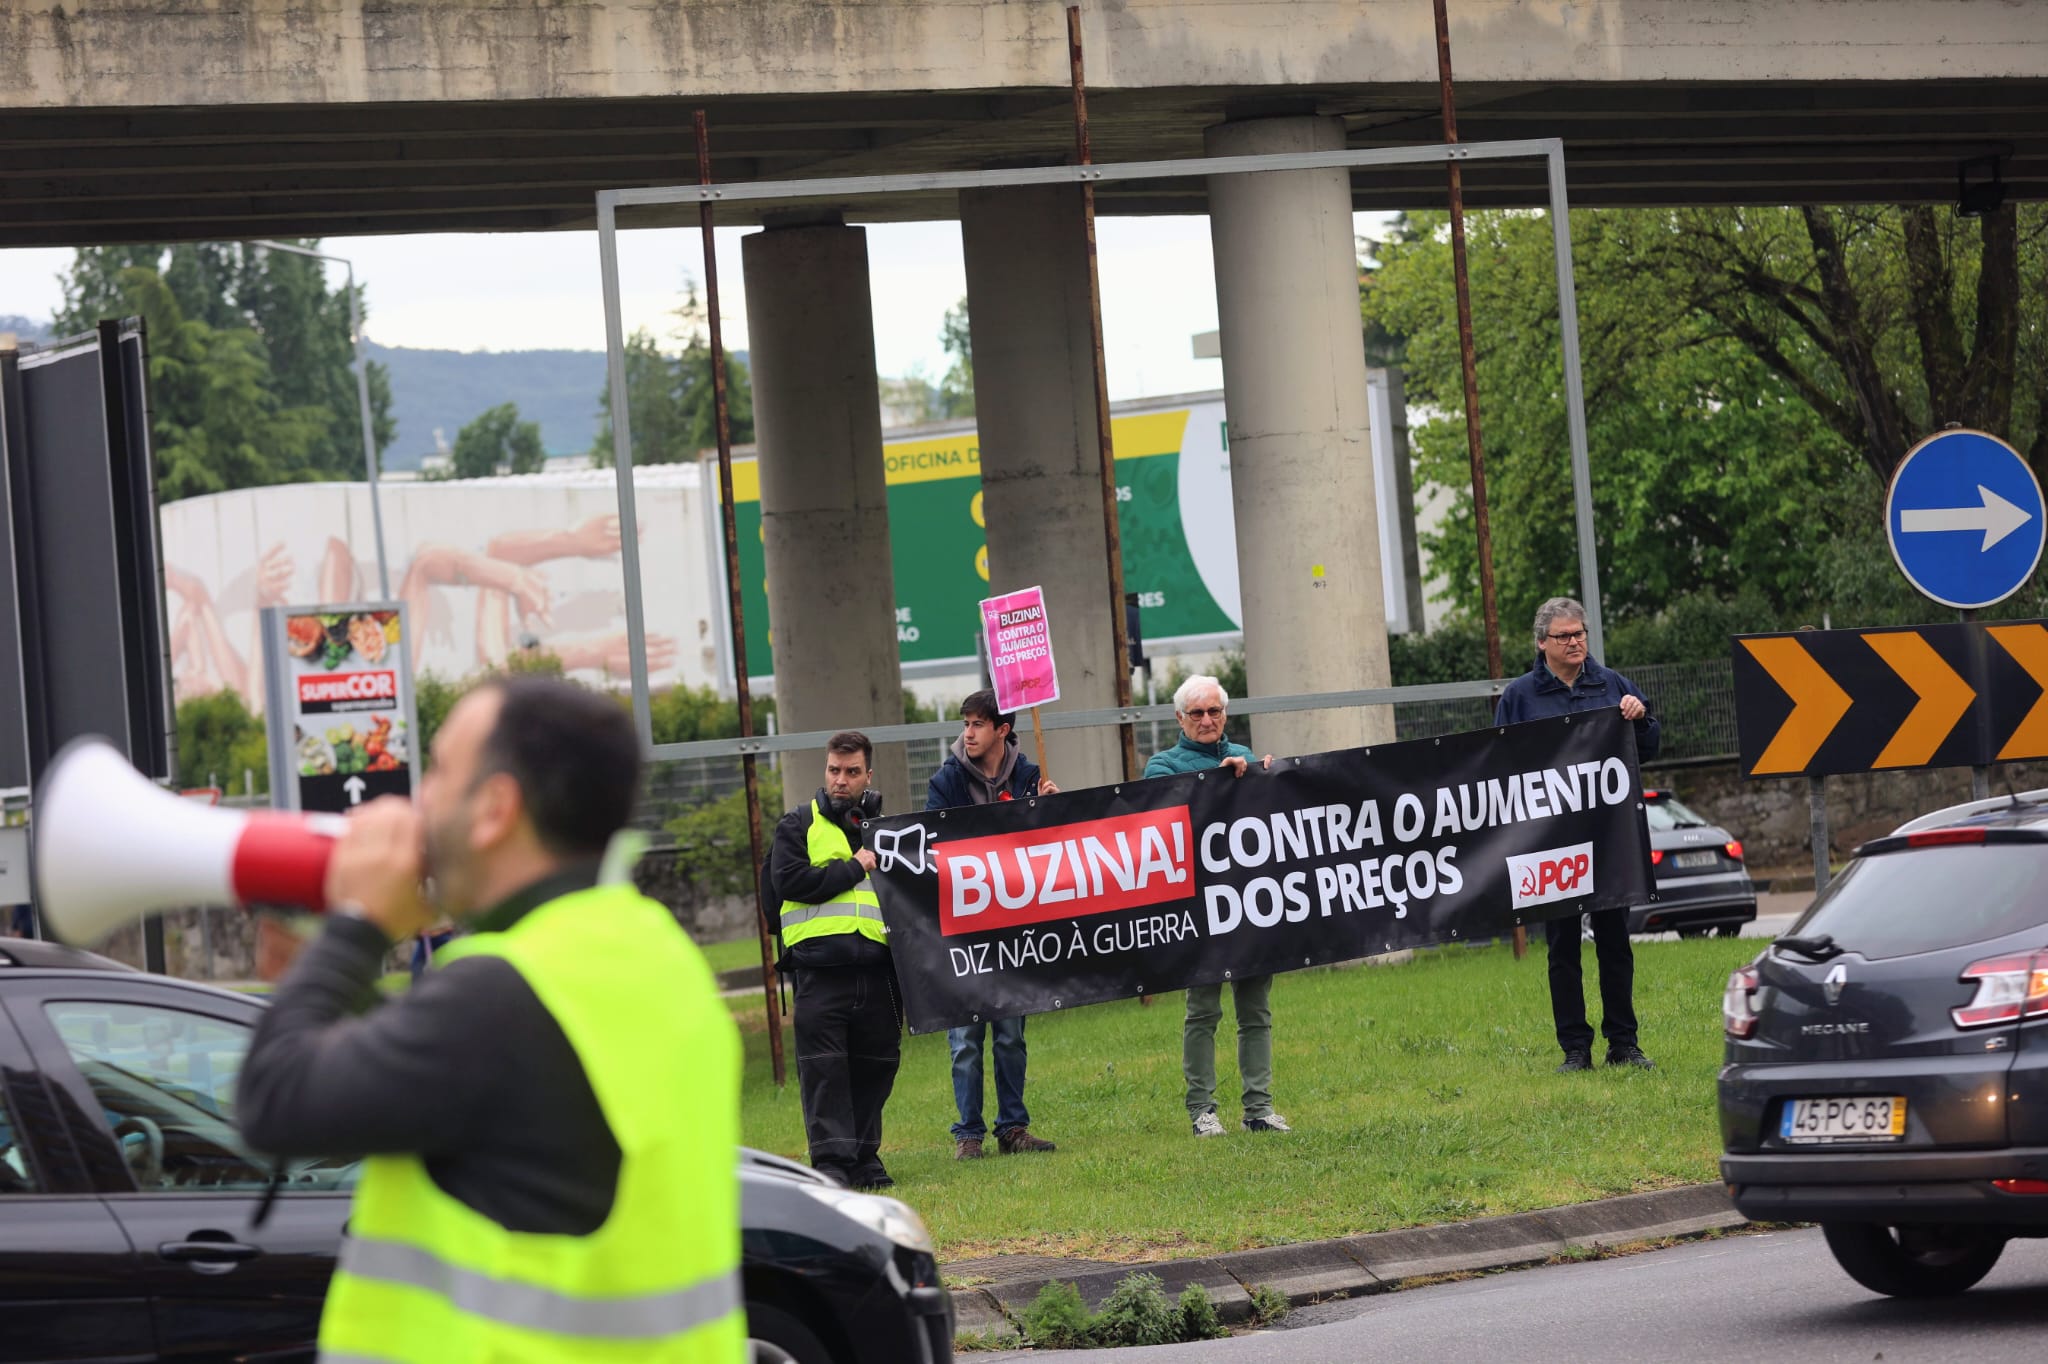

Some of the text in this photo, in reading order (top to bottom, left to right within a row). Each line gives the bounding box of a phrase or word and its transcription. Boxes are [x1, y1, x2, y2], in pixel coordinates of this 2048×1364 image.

[885, 449, 963, 473] OFICINA
[1000, 607, 1041, 626] BUZINA!
[997, 622, 1044, 642] CONTRA O
[1001, 633, 1045, 653] AUMENTO
[995, 645, 1047, 667] DOS PREÇOS
[1200, 756, 1631, 873] CONTRA O AUMENTO
[947, 821, 1188, 918] BUZINA!
[1538, 853, 1589, 896] PCP
[1204, 845, 1463, 936] DOS PREÇOS
[949, 910, 1199, 977] DIZ NÃO À GUERRA
[1801, 1022, 1870, 1036] MEGANE
